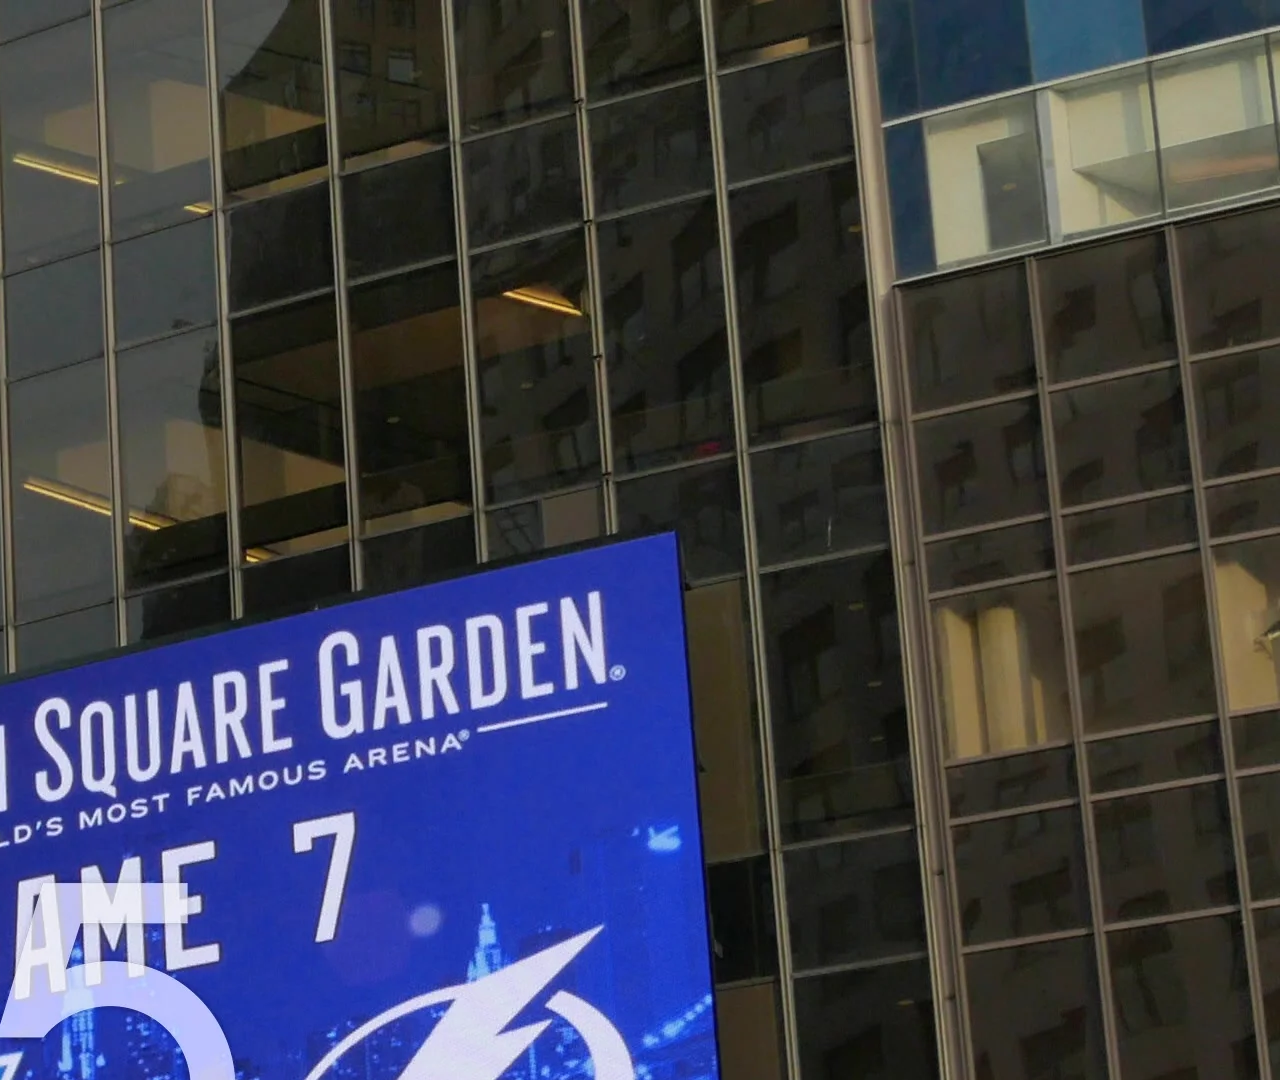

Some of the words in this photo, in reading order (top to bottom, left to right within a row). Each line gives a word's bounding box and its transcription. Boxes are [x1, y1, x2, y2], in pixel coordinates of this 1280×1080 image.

[34, 659, 294, 802] SQUARE
[78, 792, 170, 832] MOST
[187, 759, 328, 807] FAMOUS
[292, 811, 357, 944] 7
